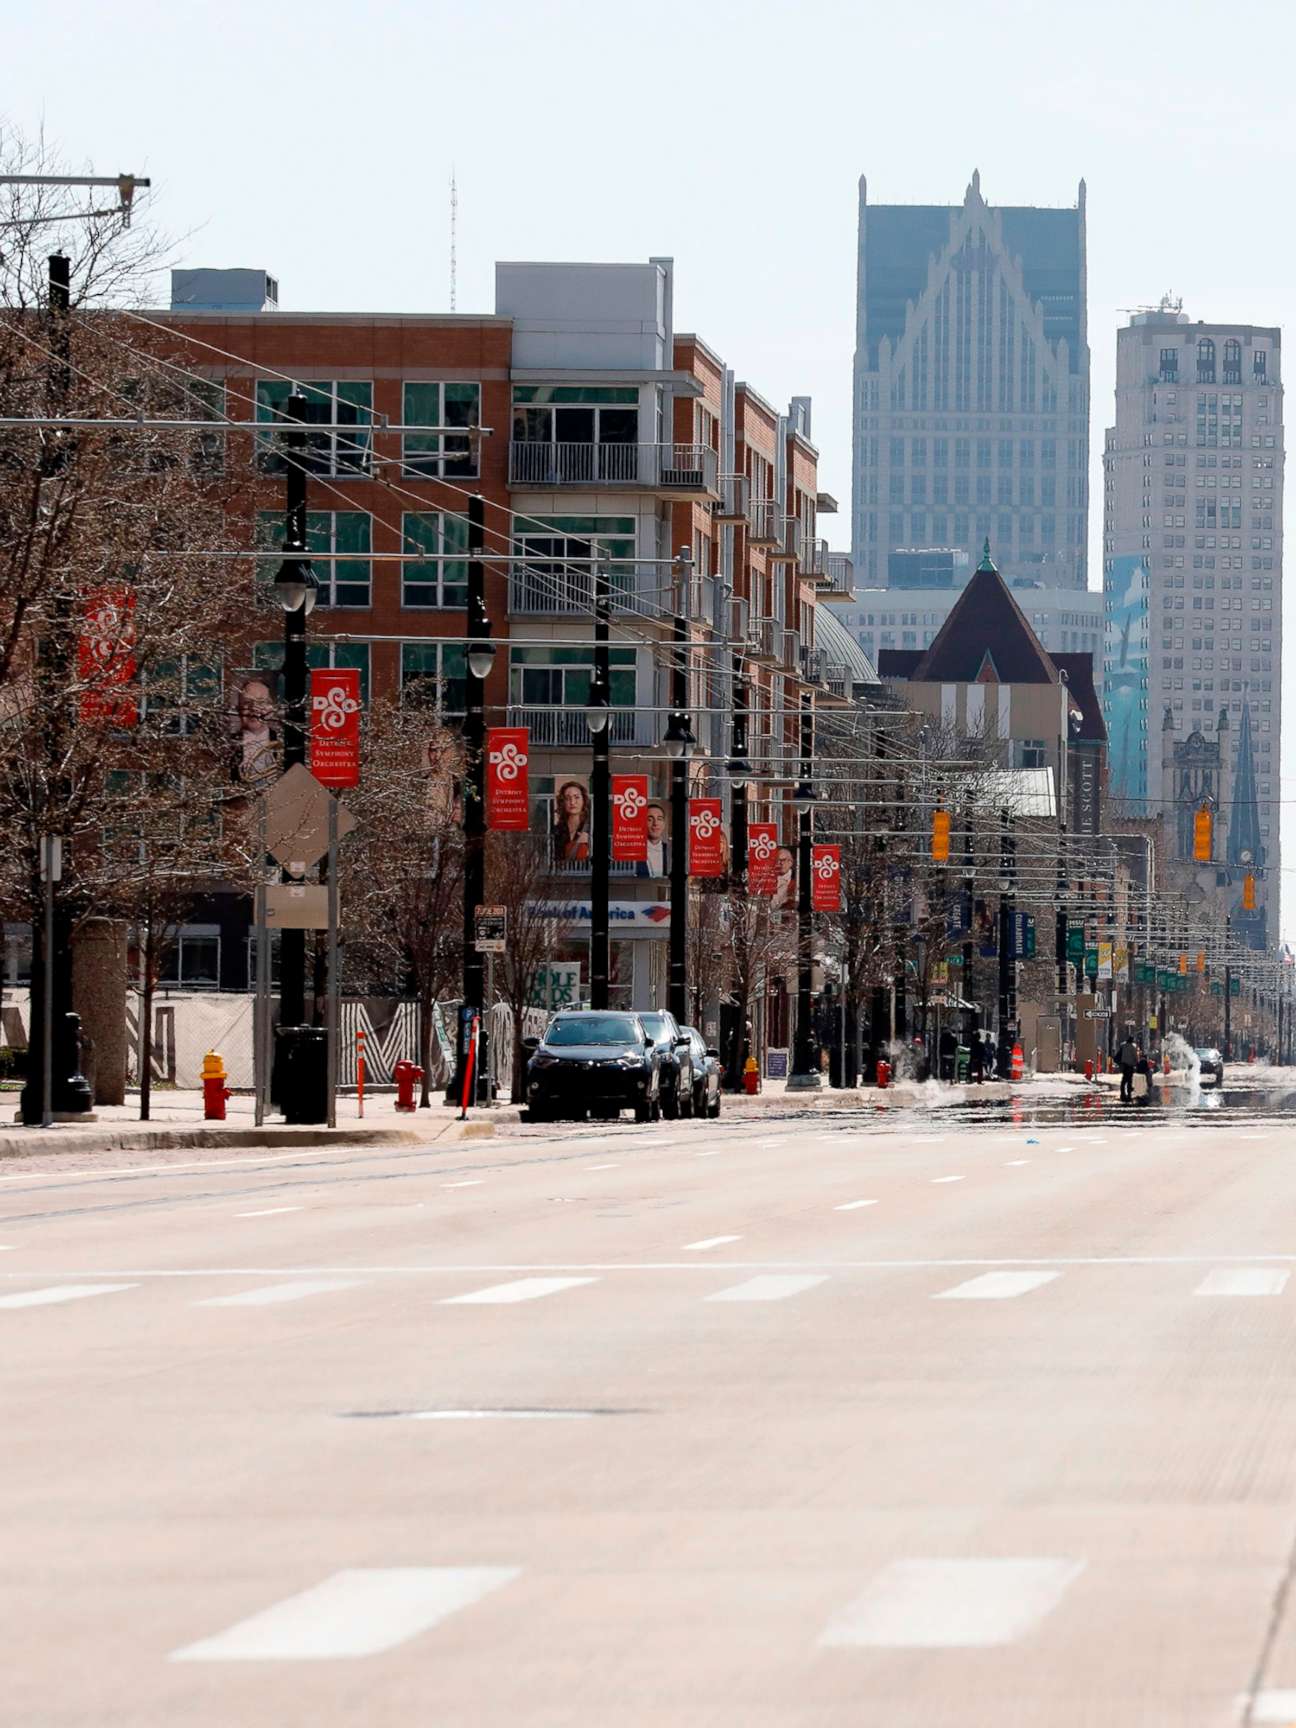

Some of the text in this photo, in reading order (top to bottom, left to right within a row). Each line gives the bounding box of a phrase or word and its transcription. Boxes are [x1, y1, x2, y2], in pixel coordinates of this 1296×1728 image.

[1082, 761, 1092, 812] SCOTT
[580, 905, 636, 919] Arica
[1015, 914, 1023, 954] COLLABORATE
